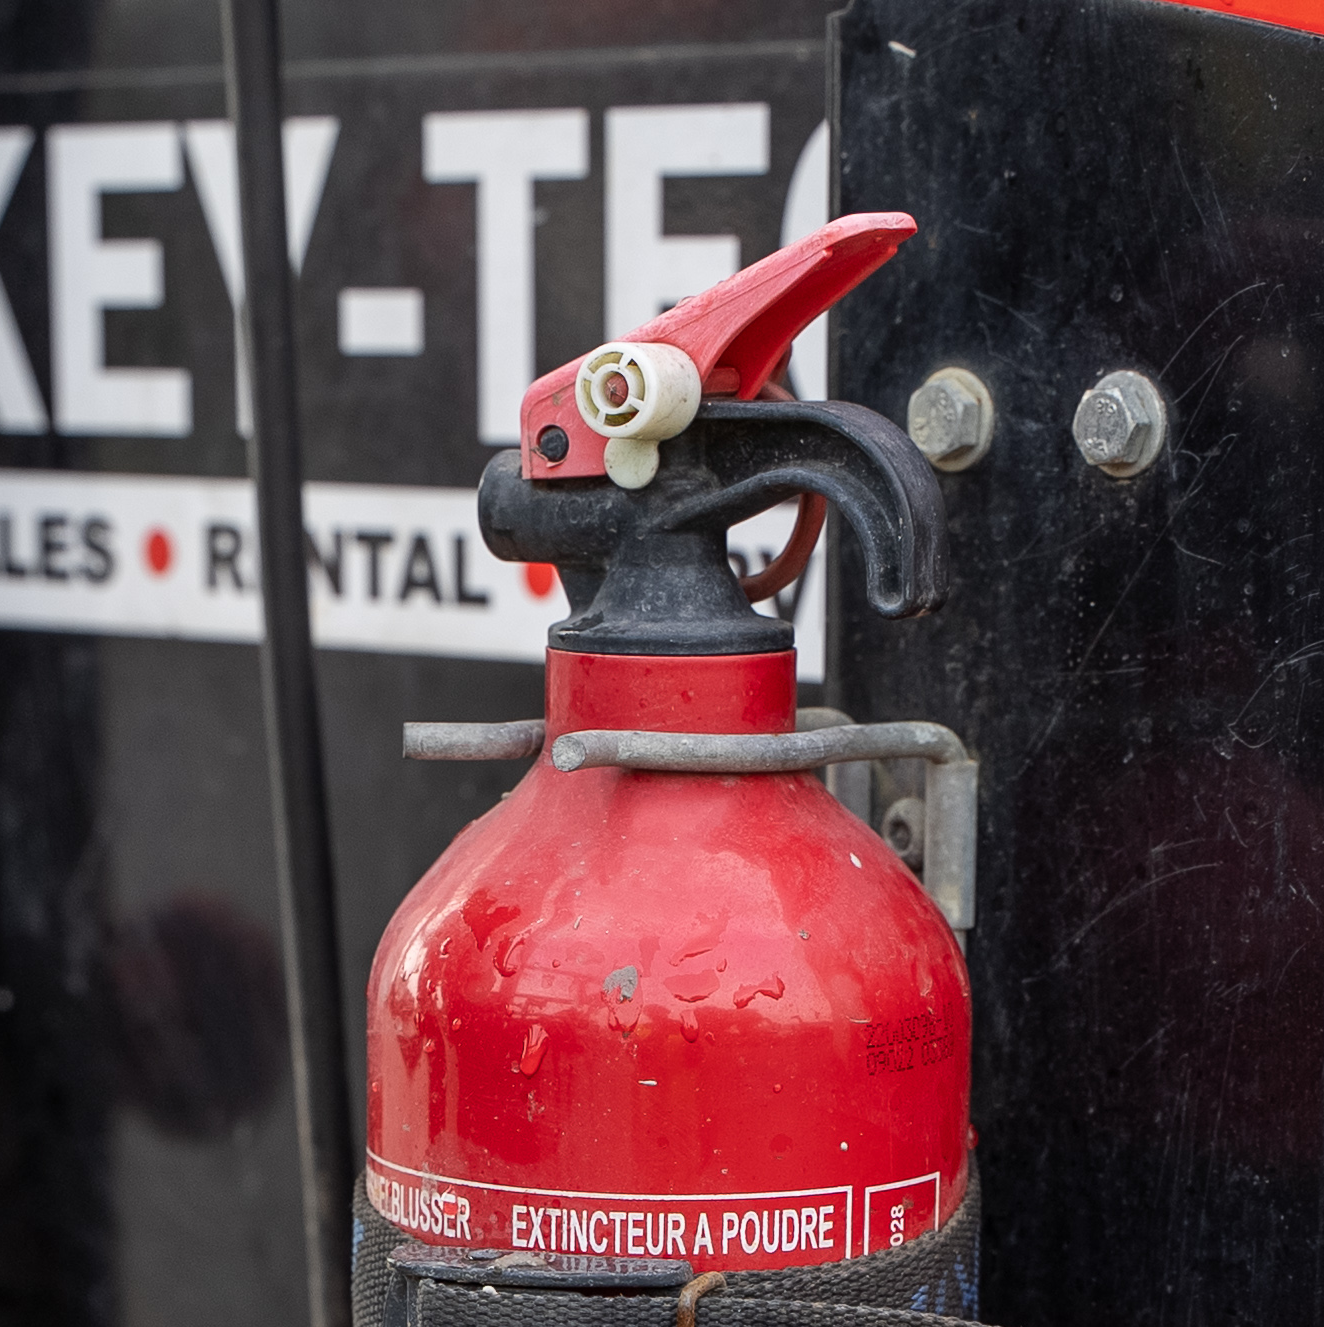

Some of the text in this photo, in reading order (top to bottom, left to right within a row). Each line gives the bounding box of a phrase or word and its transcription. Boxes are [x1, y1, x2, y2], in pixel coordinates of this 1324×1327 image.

[202, 520, 492, 607] RNTAL
[512, 1205, 835, 1256] EXTINCTEUR A POUDRE
